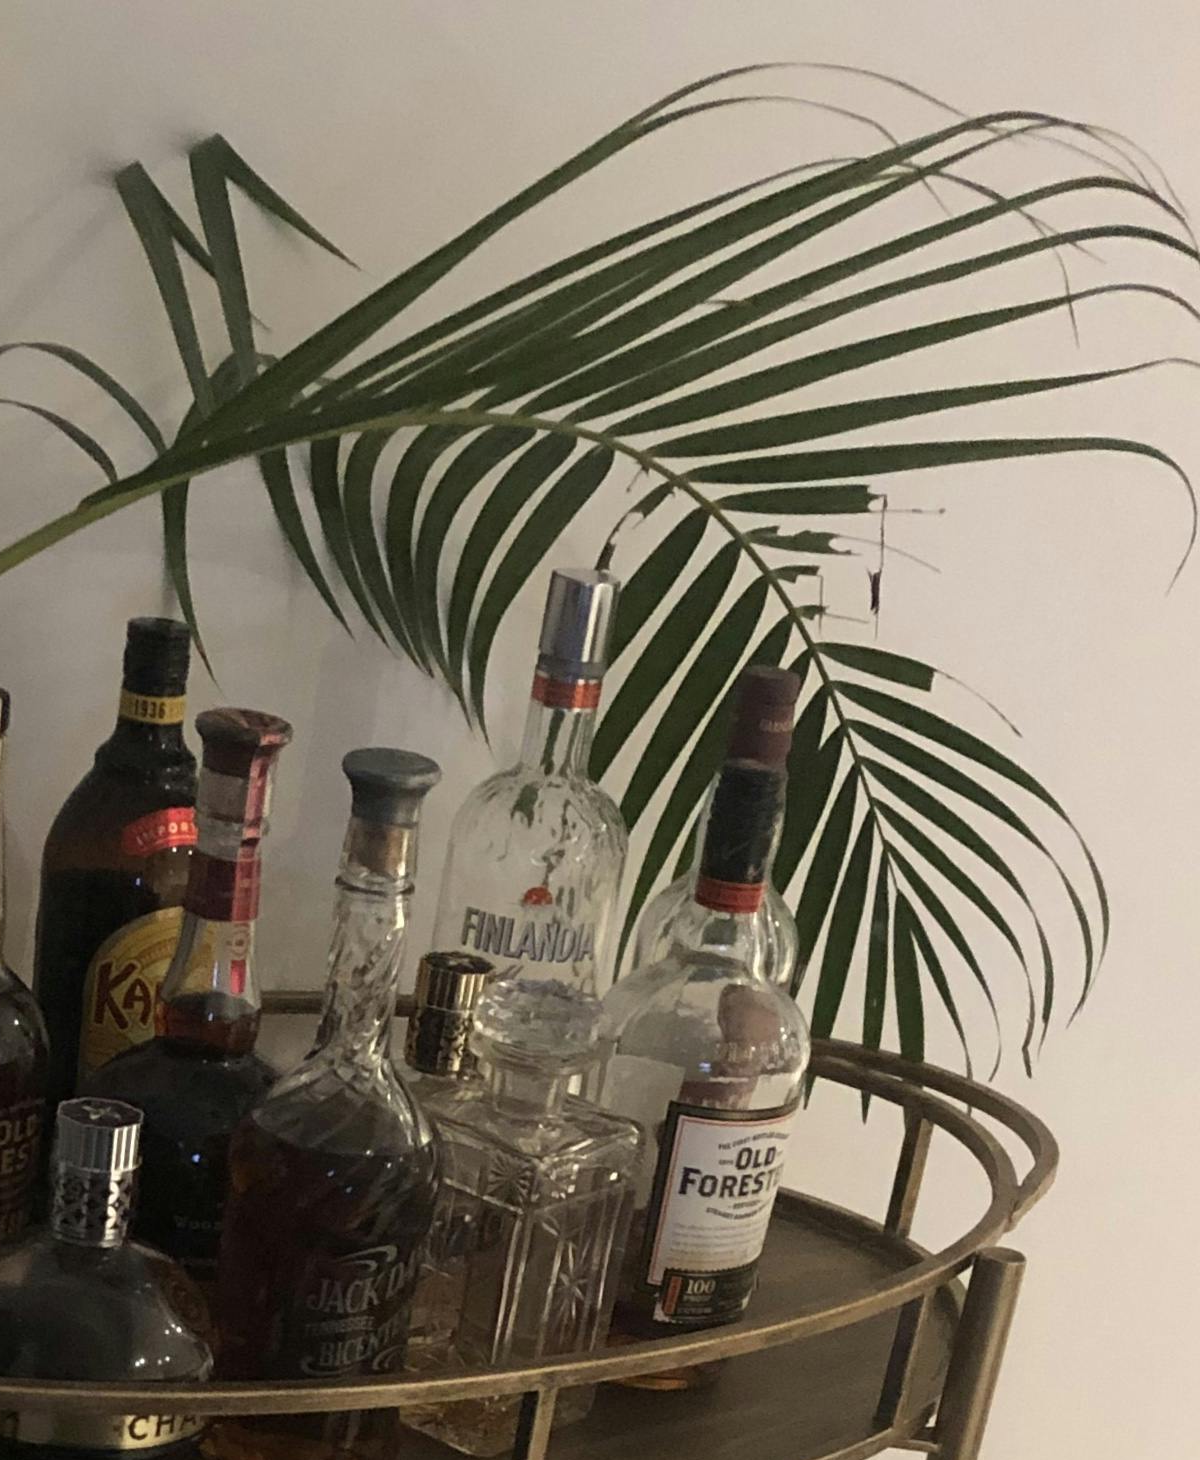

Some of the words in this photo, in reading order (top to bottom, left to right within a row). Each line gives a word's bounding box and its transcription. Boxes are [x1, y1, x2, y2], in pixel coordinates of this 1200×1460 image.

[133, 700, 166, 719] 1936
[461, 906, 594, 964] FINLANDIA
[94, 961, 164, 1030] KA
[735, 1146, 777, 1170] OLD
[306, 1271, 385, 1315] JACK
[685, 1279, 716, 1295] 100
